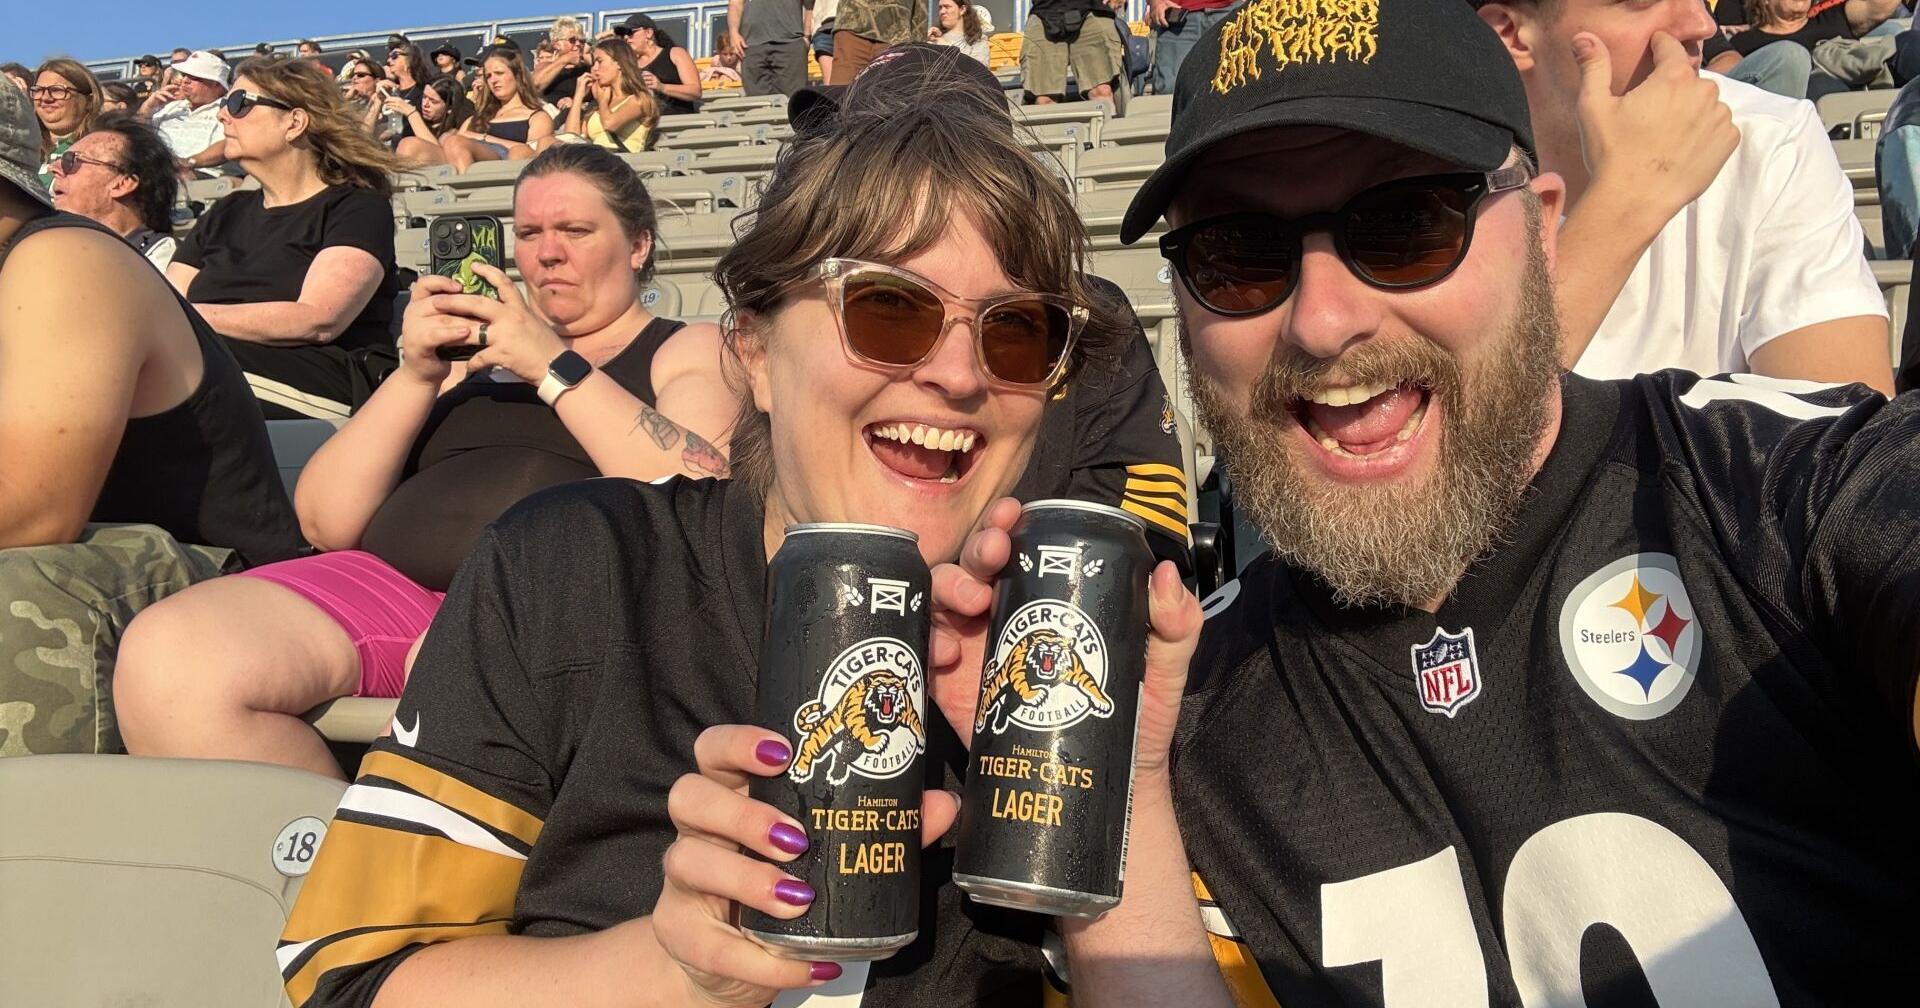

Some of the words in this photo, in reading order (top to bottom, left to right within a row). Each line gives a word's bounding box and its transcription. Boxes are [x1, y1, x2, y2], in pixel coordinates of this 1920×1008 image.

[1268, 13, 1379, 71] PAPER
[643, 292, 656, 304] 19
[1003, 607, 1099, 655] TIGER-CATS
[1580, 628, 1636, 645] Steelers
[830, 646, 920, 693] TIGER-CATS
[1423, 662, 1471, 704] NFL
[1020, 699, 1085, 722] FOOTBALL
[863, 740, 915, 770] FOOTBALL
[979, 755, 1094, 789] TIGER-CATS
[811, 808, 920, 831] TIGER-CATS
[991, 787, 1064, 827] LAGER
[282, 831, 317, 863] 18
[839, 842, 905, 874] LAGER
